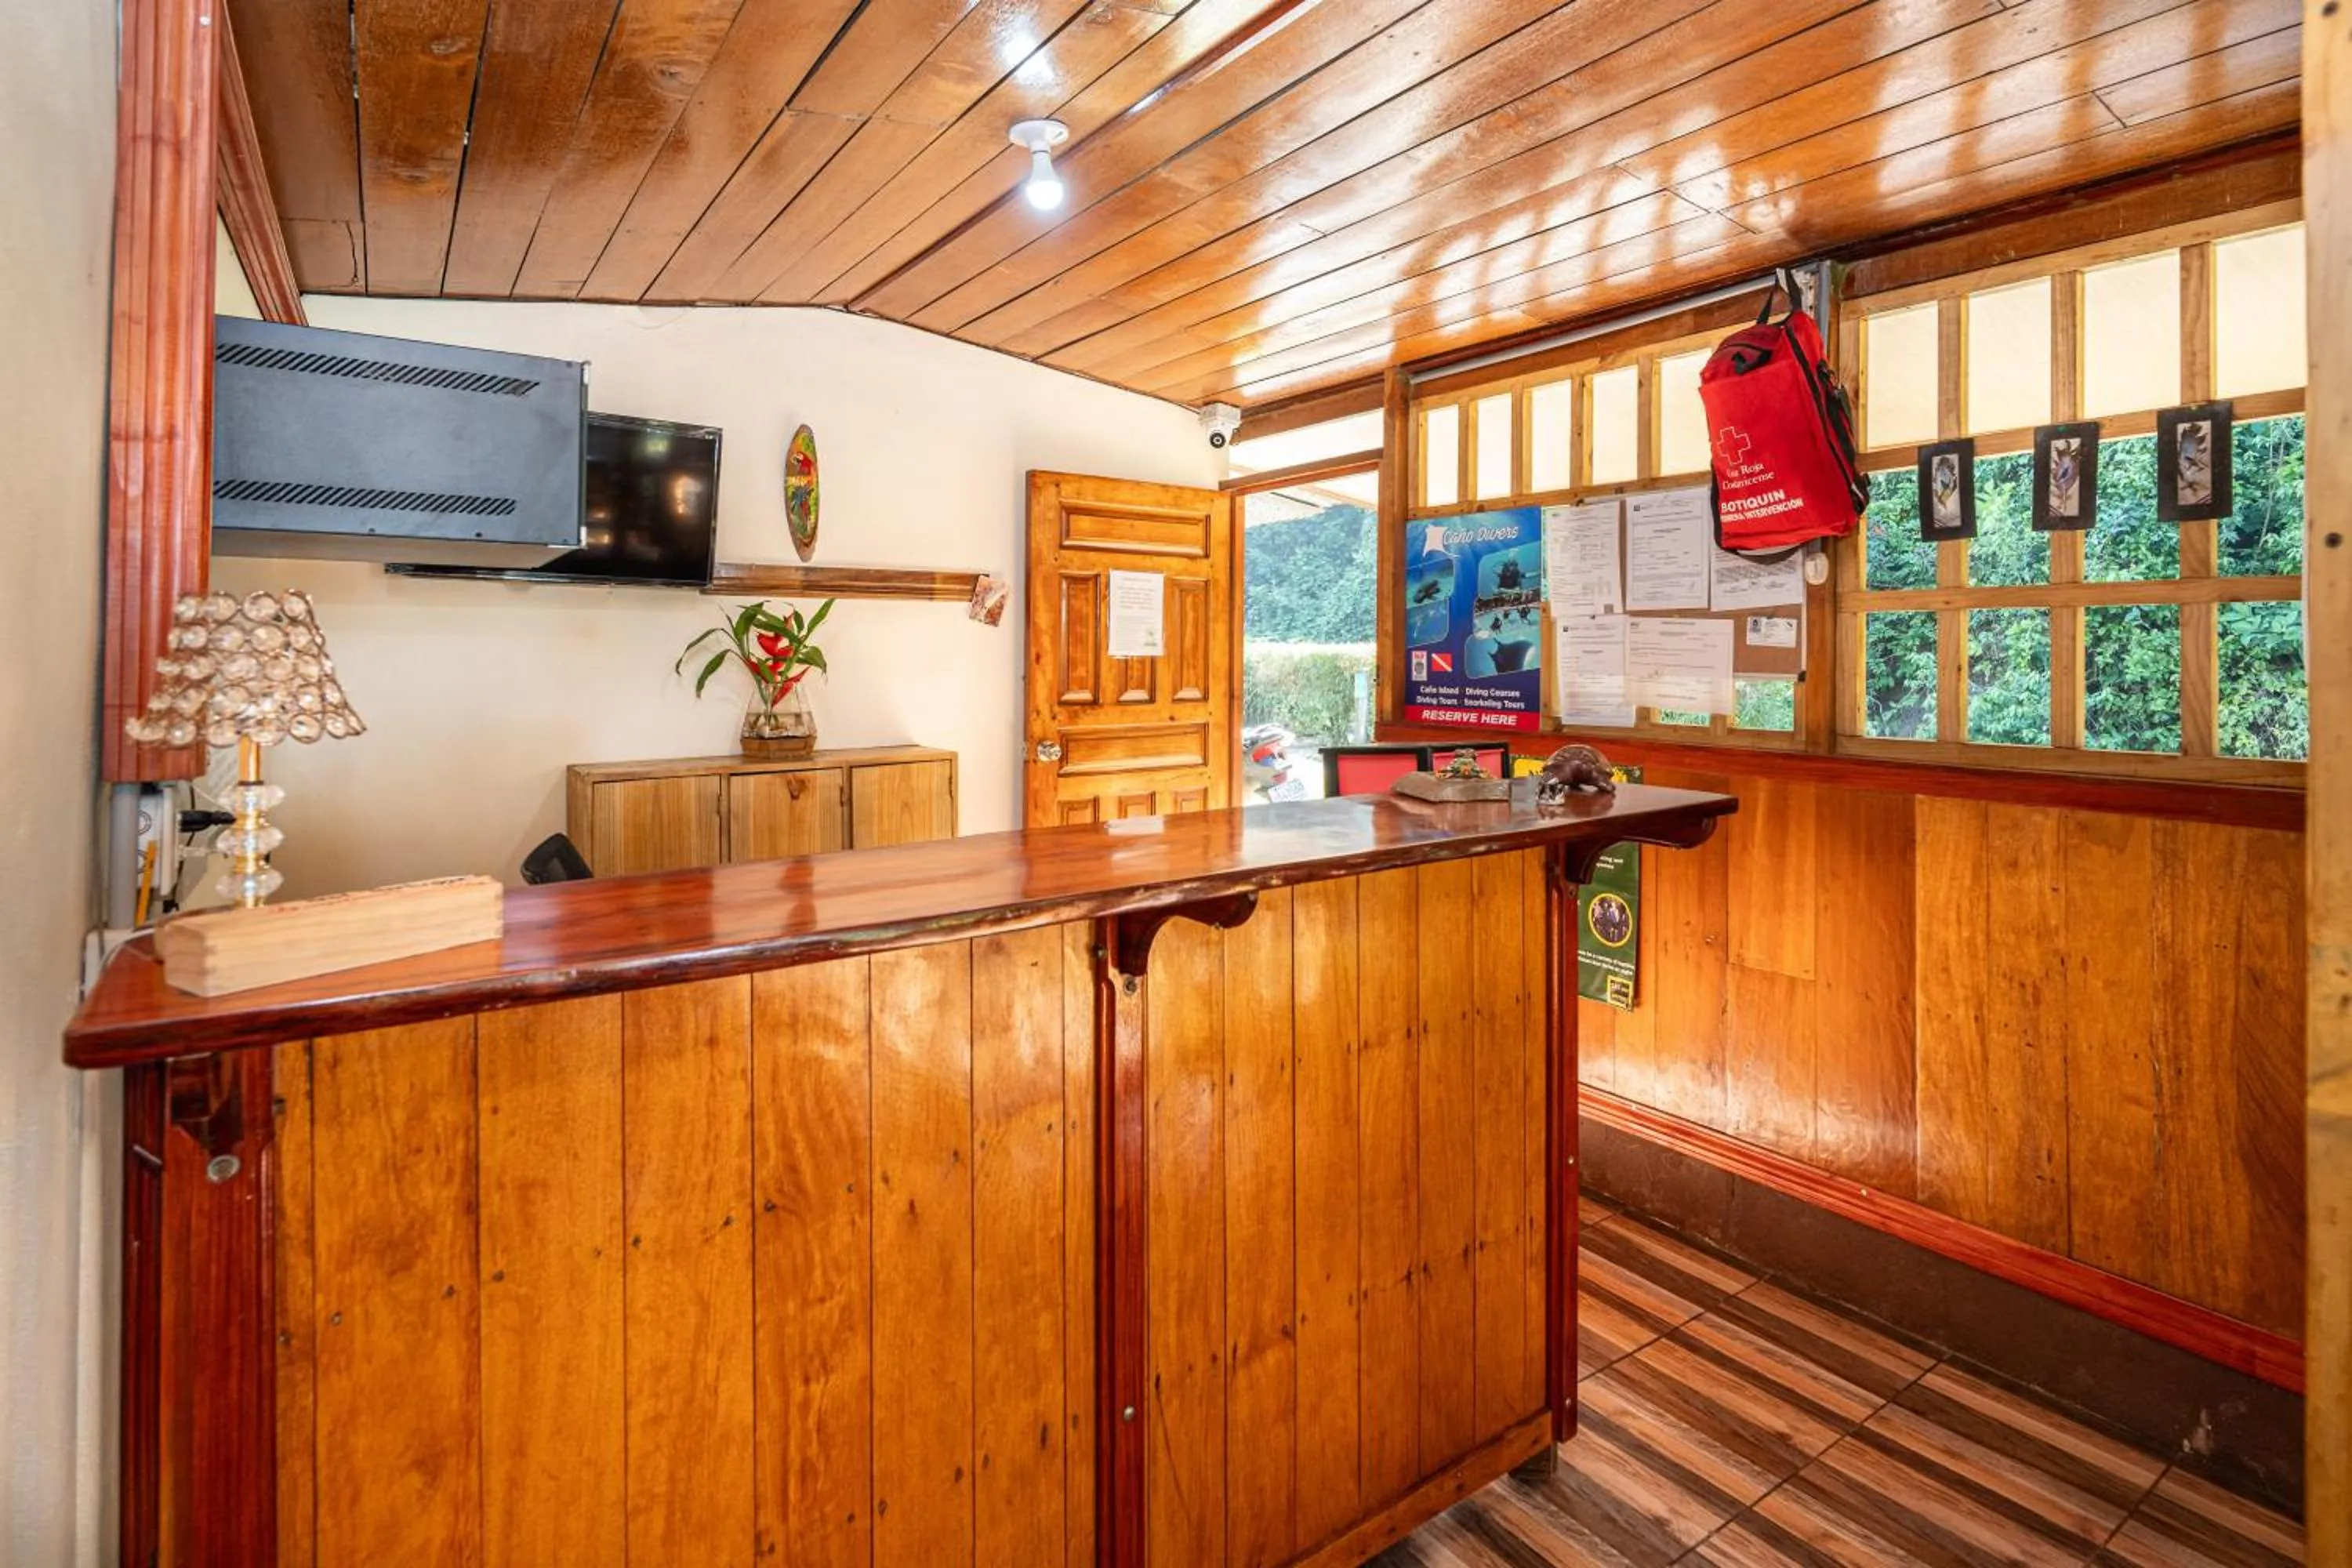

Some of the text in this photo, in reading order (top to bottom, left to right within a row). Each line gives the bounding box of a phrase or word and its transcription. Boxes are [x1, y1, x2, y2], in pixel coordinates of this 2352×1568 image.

[1721, 488, 1785, 514] BOTIQUIN
[1477, 526, 1519, 543] Divers
[1465, 687, 1489, 697] Diving
[1490, 688, 1520, 698] Courses
[1417, 696, 1437, 705] Diving
[1504, 700, 1525, 710] Tours
[1421, 709, 1518, 726] RESERVE HERE
